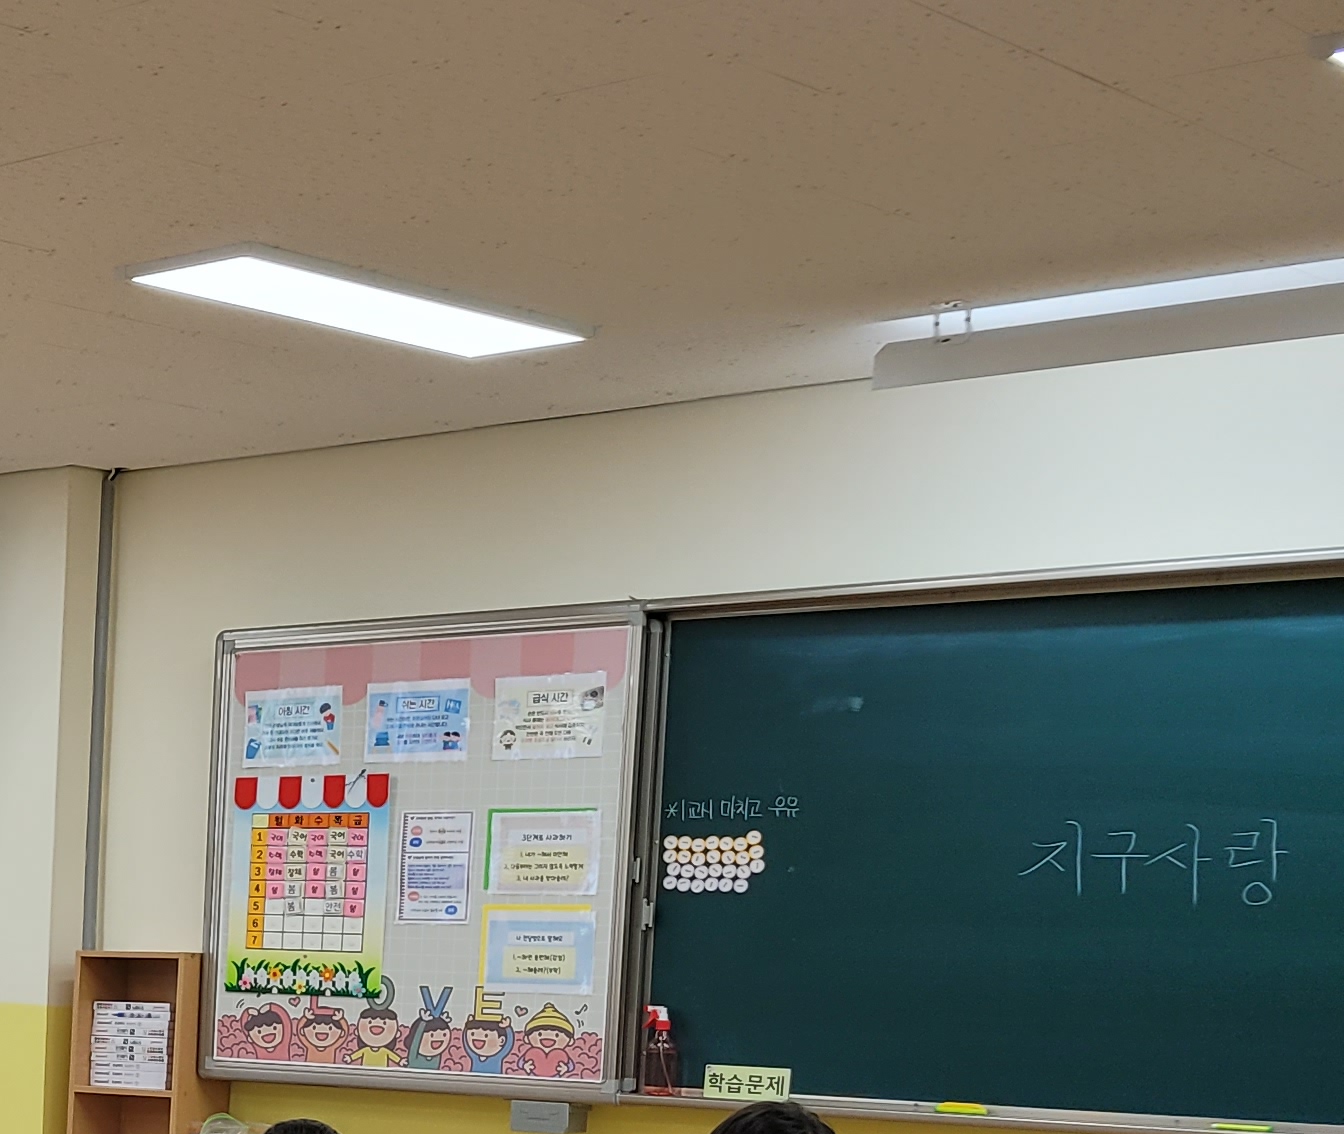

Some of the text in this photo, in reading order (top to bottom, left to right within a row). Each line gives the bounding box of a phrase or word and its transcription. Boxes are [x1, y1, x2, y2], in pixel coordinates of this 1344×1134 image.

[532, 692, 568, 704] 급식 시간
[401, 699, 435, 709] 쉬는 시간
[295, 706, 310, 716] 시간
[720, 795, 763, 821] 마치고
[314, 816, 323, 825] 수
[353, 815, 363, 826] 금
[257, 832, 263, 841] 1
[292, 832, 308, 840] 국어
[330, 831, 346, 840] 국어
[257, 850, 263, 859] 2
[329, 850, 345, 859] 국어
[255, 866, 261, 876] 3
[254, 884, 260, 893] 4
[253, 901, 259, 911] 5
[252, 918, 258, 928] 6
[252, 935, 258, 944] 7
[708, 1072, 785, 1097] 학습문제
